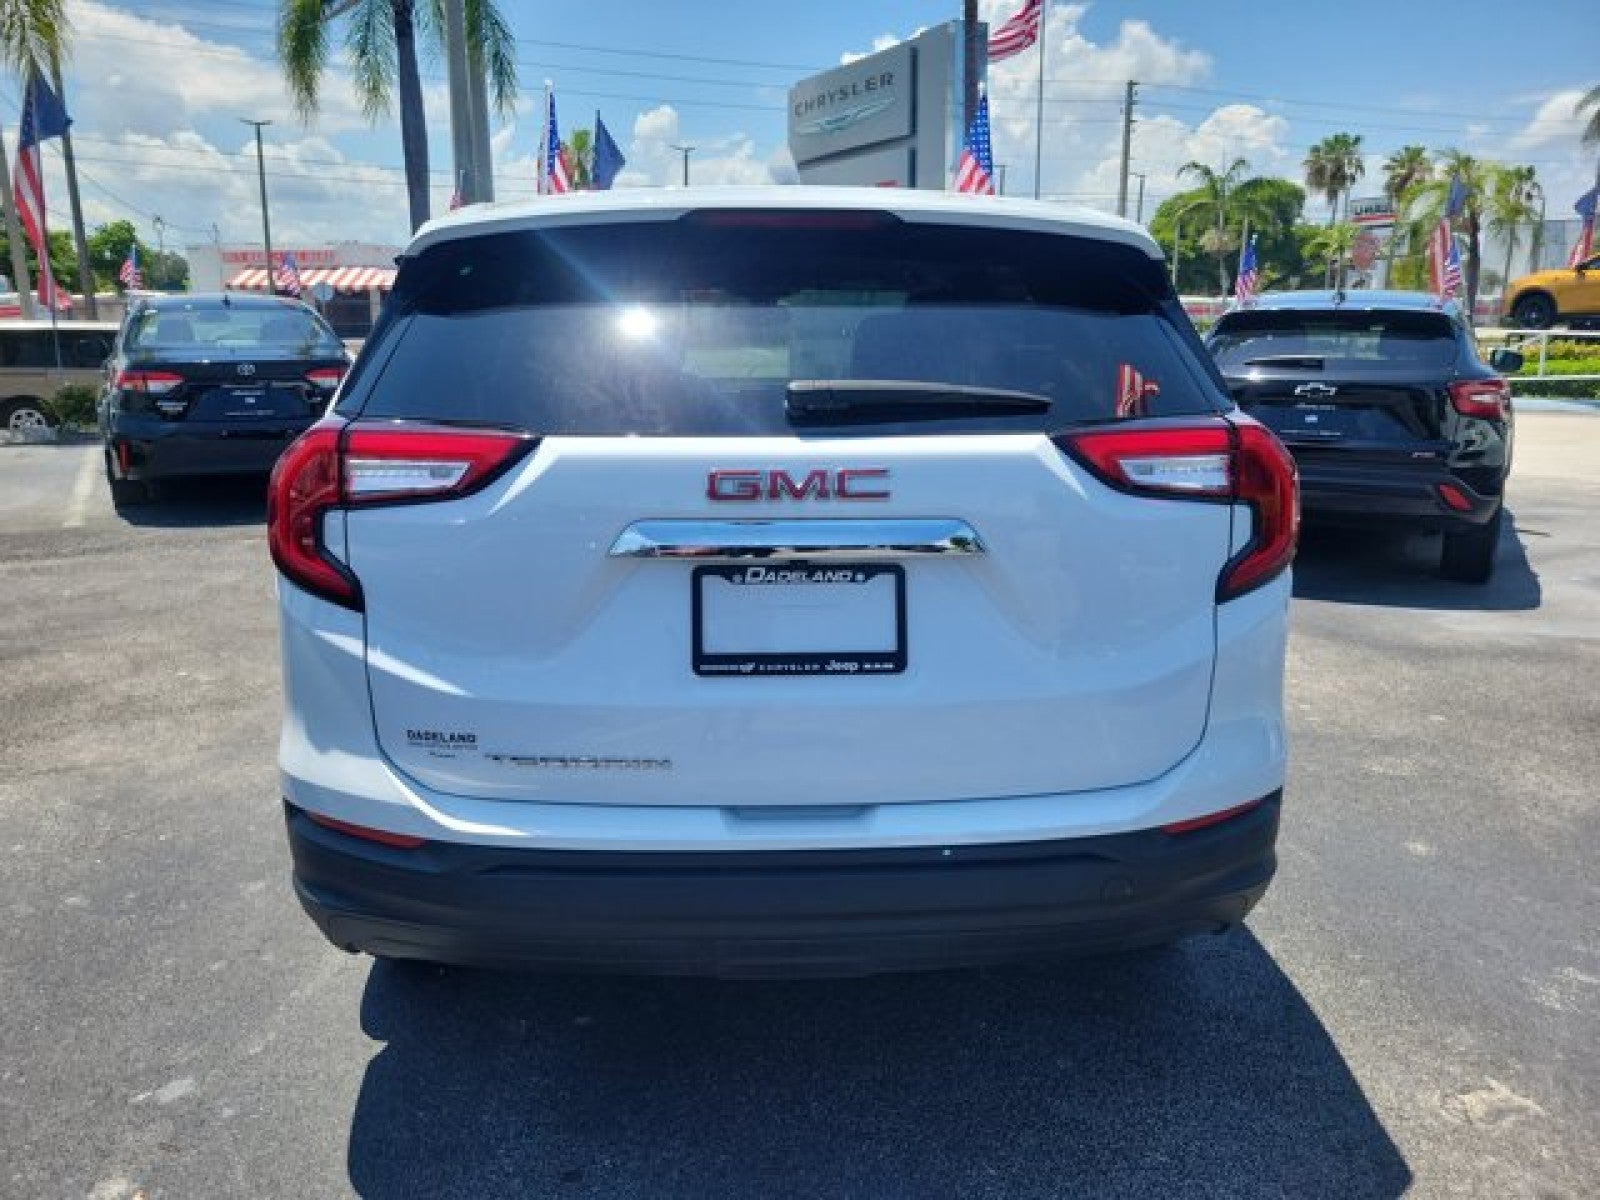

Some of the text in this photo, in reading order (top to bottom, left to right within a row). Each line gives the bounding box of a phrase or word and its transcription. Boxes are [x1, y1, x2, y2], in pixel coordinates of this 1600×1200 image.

[794, 71, 895, 117] CHRYSLER
[706, 468, 891, 501] GMC
[825, 659, 859, 674] Jeep
